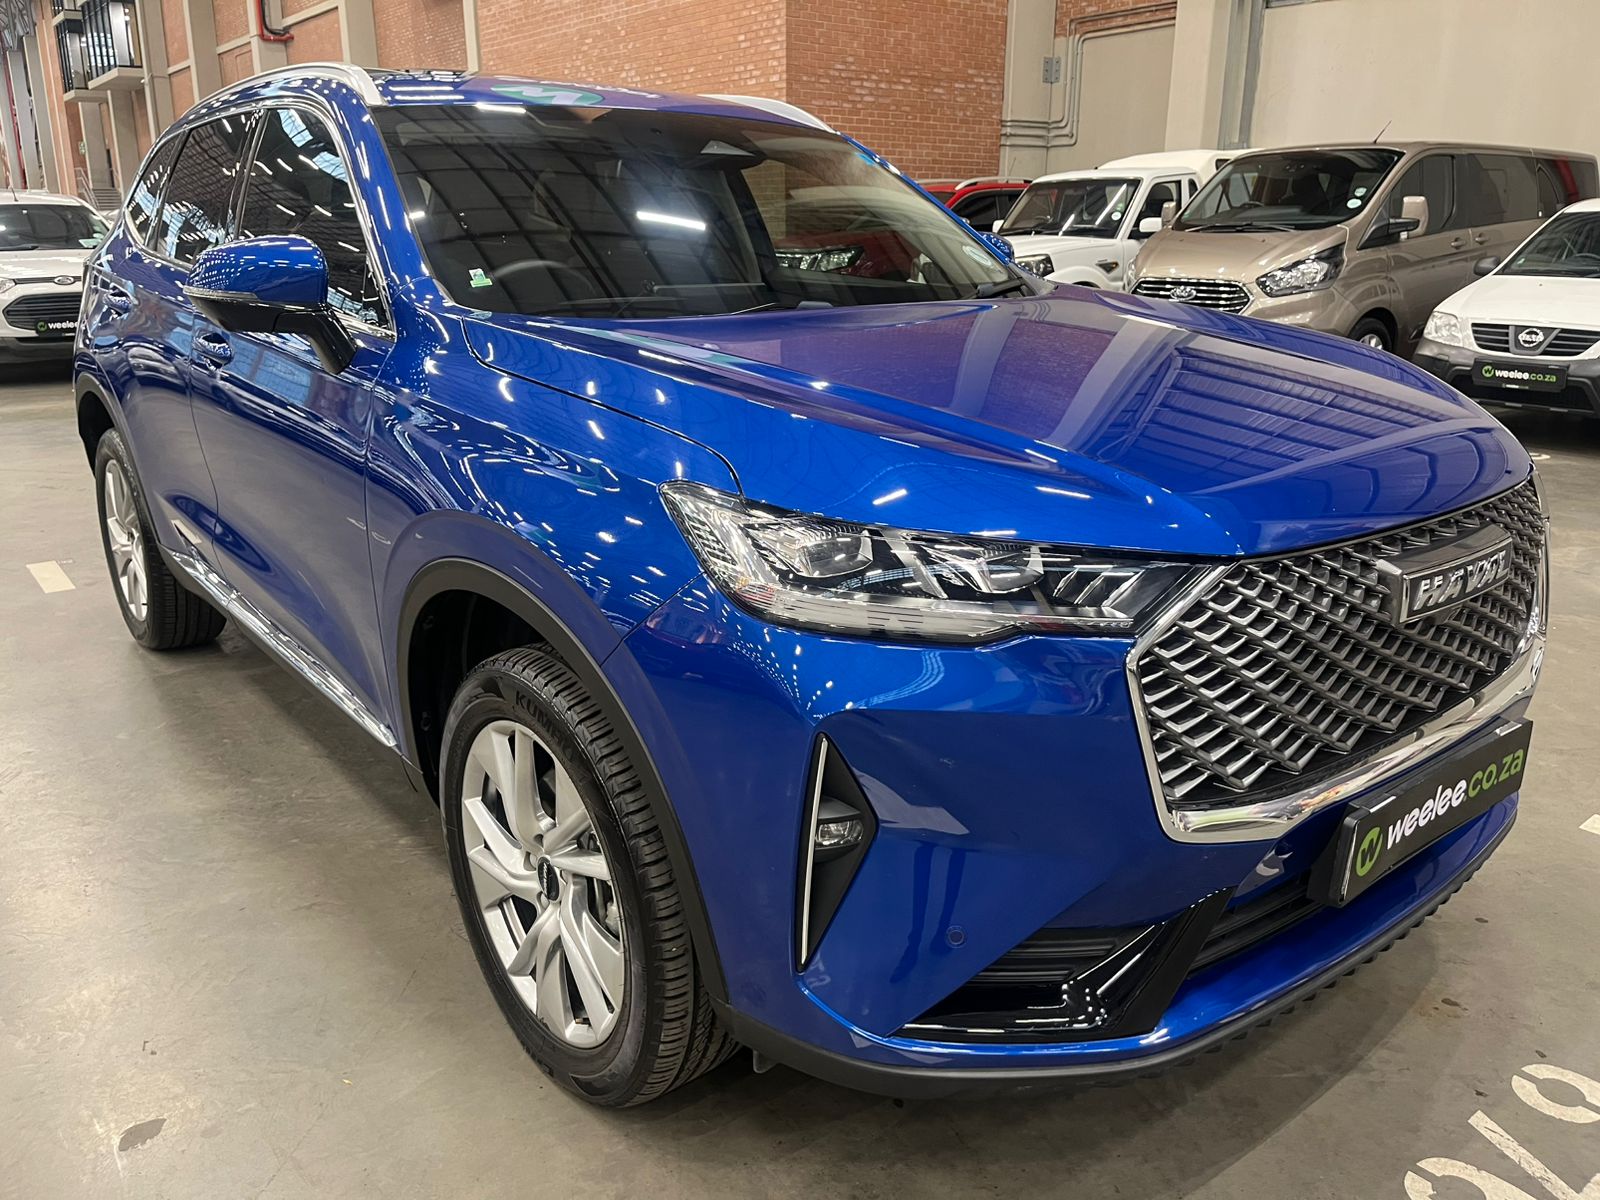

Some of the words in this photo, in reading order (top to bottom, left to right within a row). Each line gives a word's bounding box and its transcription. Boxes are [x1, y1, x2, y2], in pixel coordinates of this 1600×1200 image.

[1495, 369, 1556, 382] weelee.co.za
[1413, 550, 1507, 611] HAVAL
[1387, 749, 1523, 849] weelee.co.za
